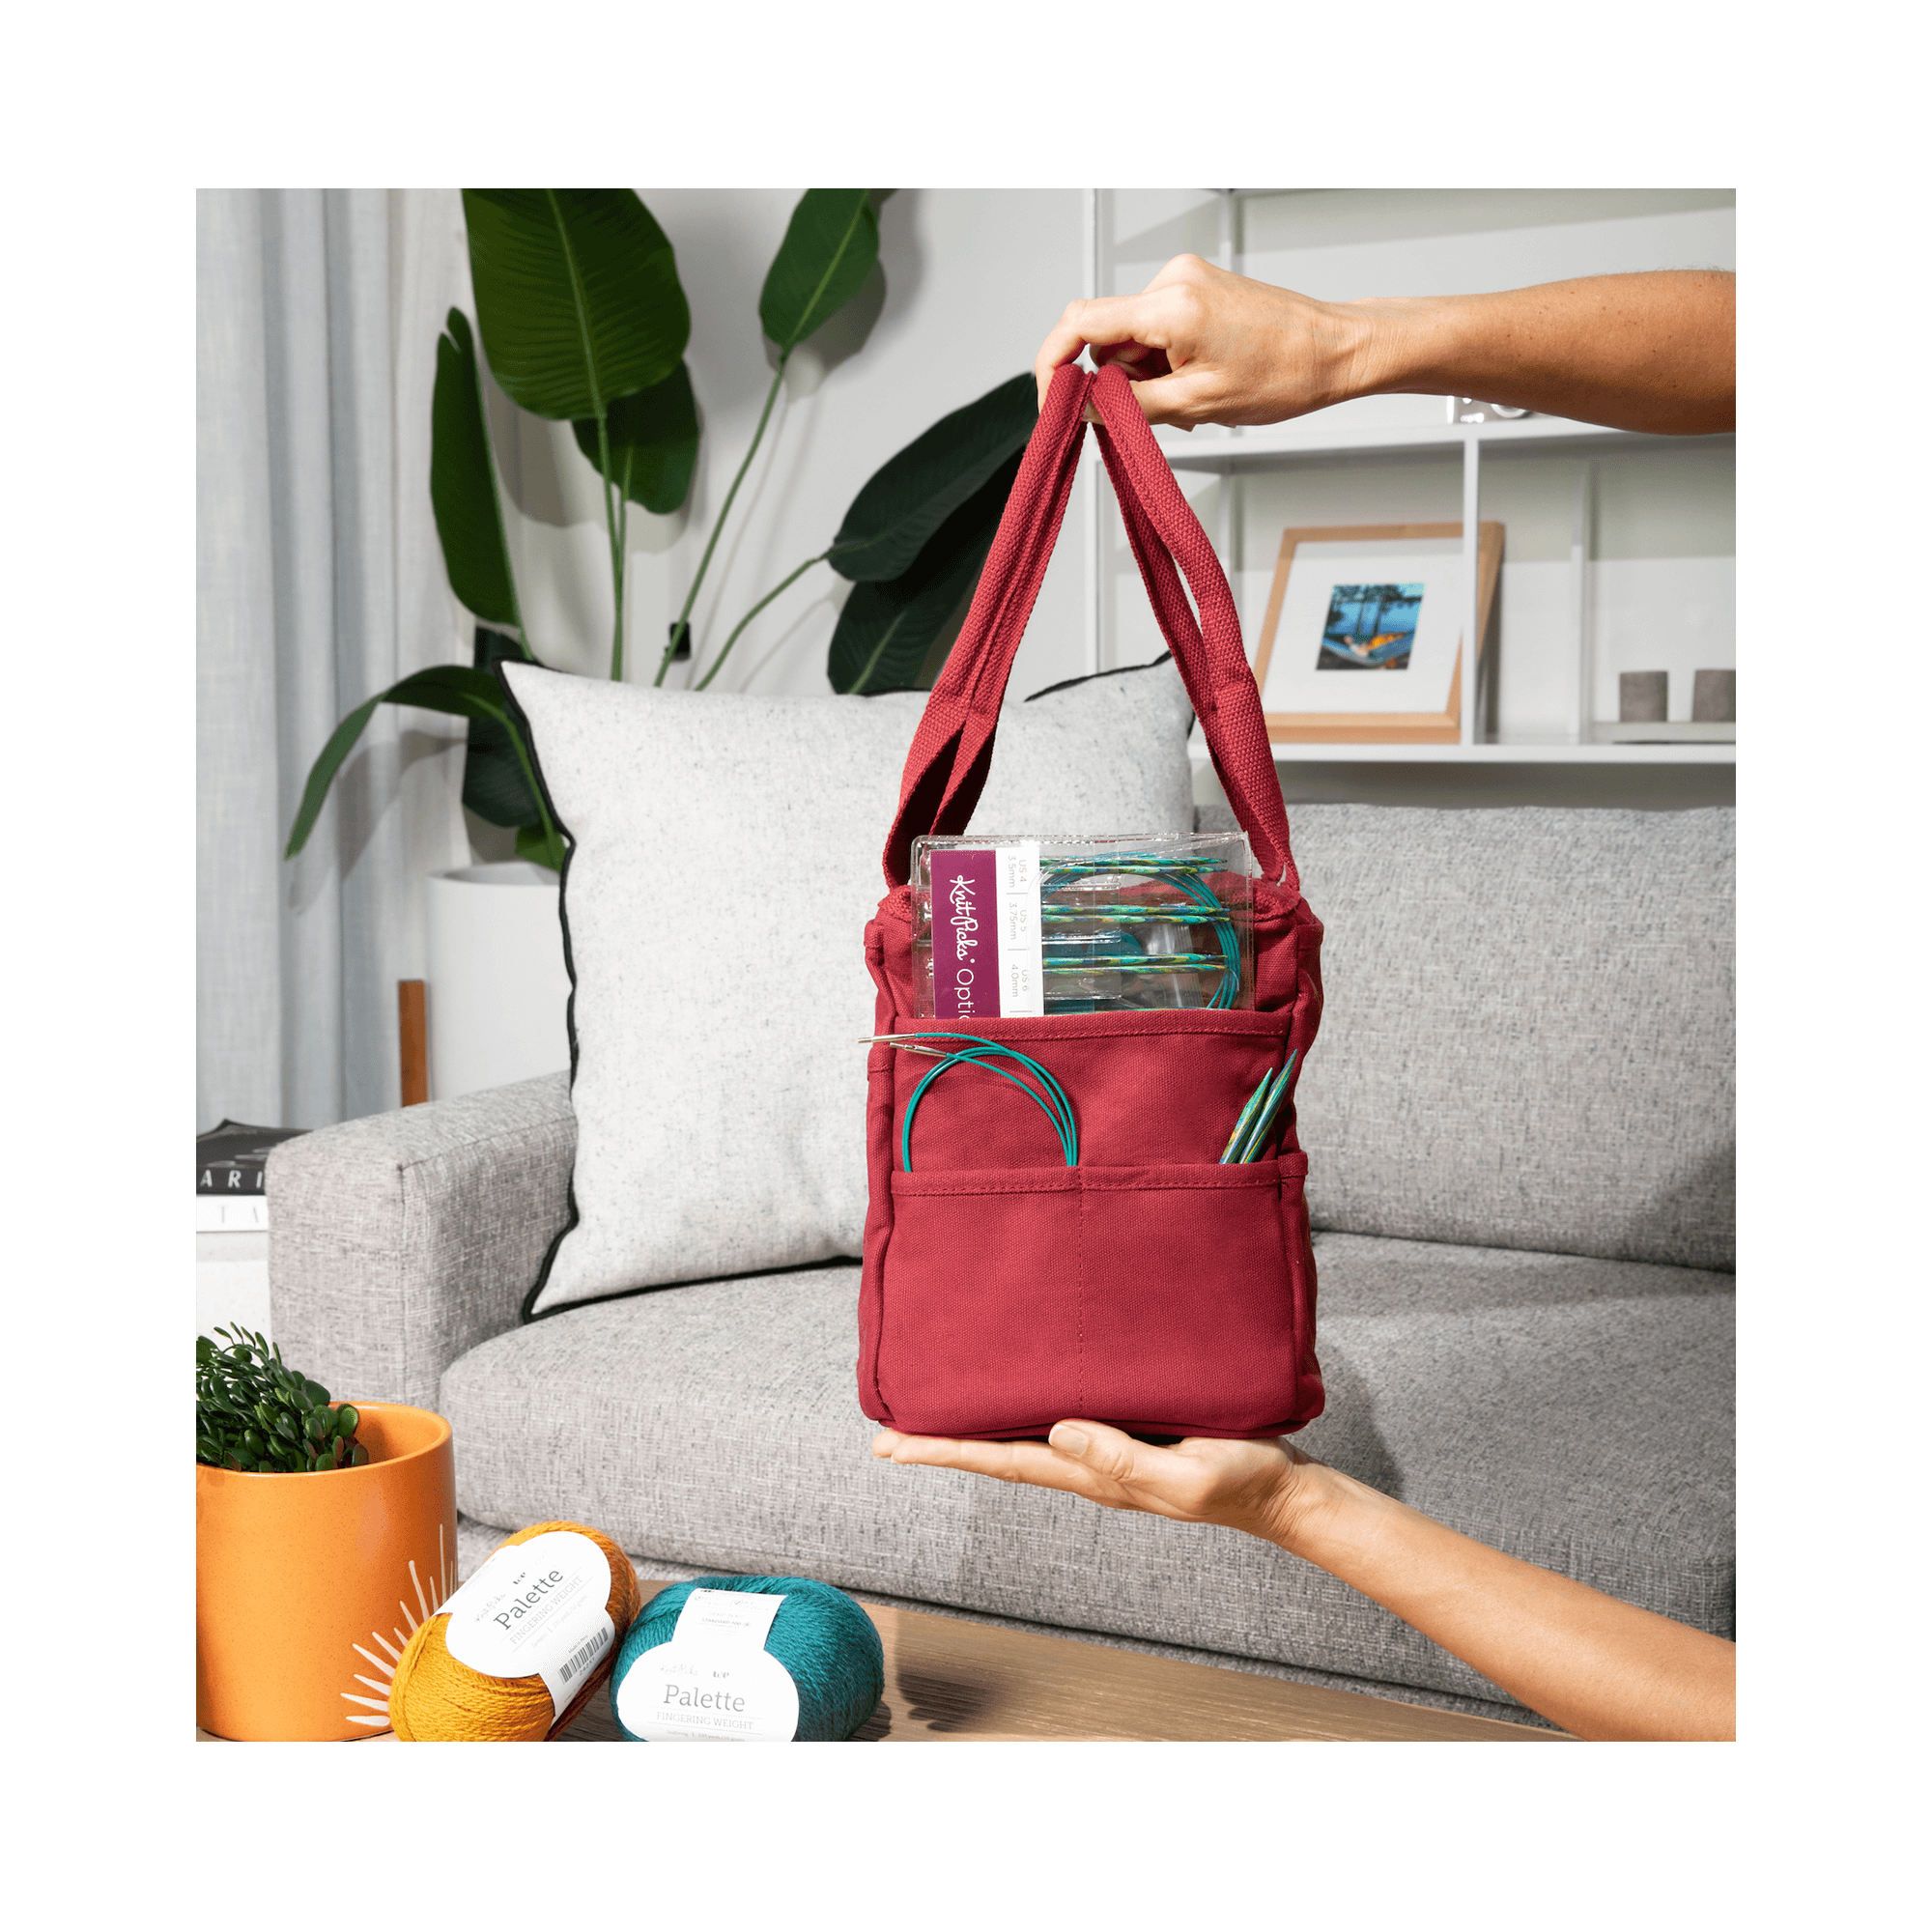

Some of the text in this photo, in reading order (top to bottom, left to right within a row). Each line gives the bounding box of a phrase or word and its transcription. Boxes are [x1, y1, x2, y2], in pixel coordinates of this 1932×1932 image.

[1008, 855, 1016, 888] 3.5mm
[1019, 859, 1028, 873] US
[1009, 901, 1018, 941] 3.75mm
[1019, 909, 1028, 923] US
[1011, 963, 1020, 998] 4.0mm
[1021, 969, 1030, 982] US
[493, 1570, 564, 1631] Palette
[509, 1575, 582, 1645] FINGERING WEIGHT
[663, 1684, 746, 1713] Palette
[656, 1711, 754, 1730] FINGERING WEIGHT
